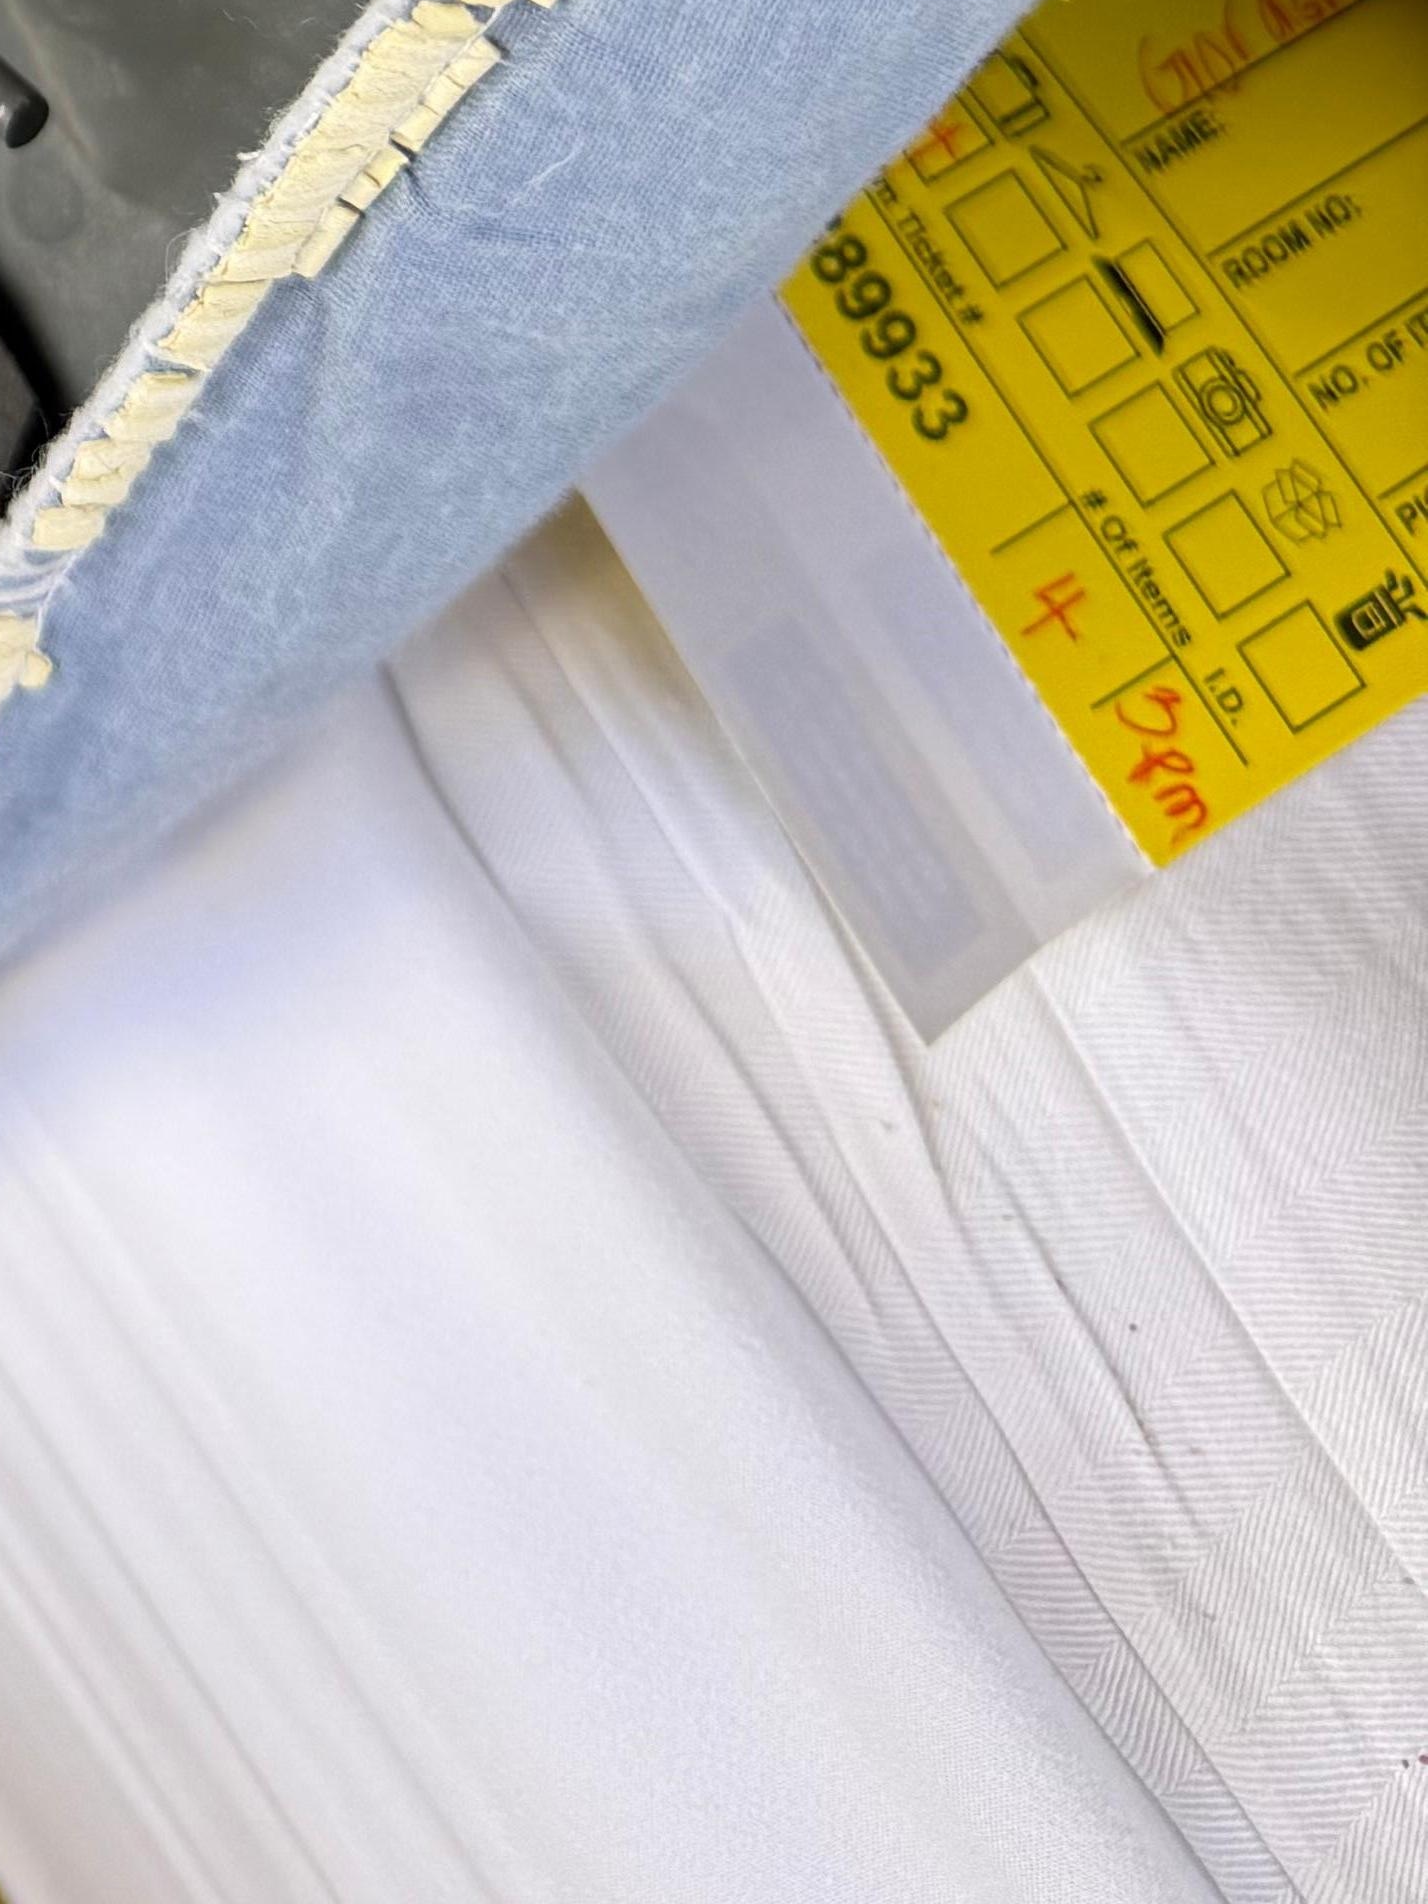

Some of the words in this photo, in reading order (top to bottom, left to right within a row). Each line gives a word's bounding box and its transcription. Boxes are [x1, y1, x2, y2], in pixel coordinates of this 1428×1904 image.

[1134, 109, 1228, 176] NAME:
[896, 210, 966, 308] Ticket
[1220, 217, 1312, 291] ROOM
[1305, 194, 1363, 239] NO:
[808, 214, 970, 443] 89933
[1307, 363, 1371, 413] NO.
[1365, 328, 1405, 373] OF
[1020, 570, 1086, 643] 4
[1082, 489, 1108, 513] #
[1099, 514, 1139, 560] Of
[1127, 558, 1193, 649] Items
[1203, 666, 1245, 727] I.D.
